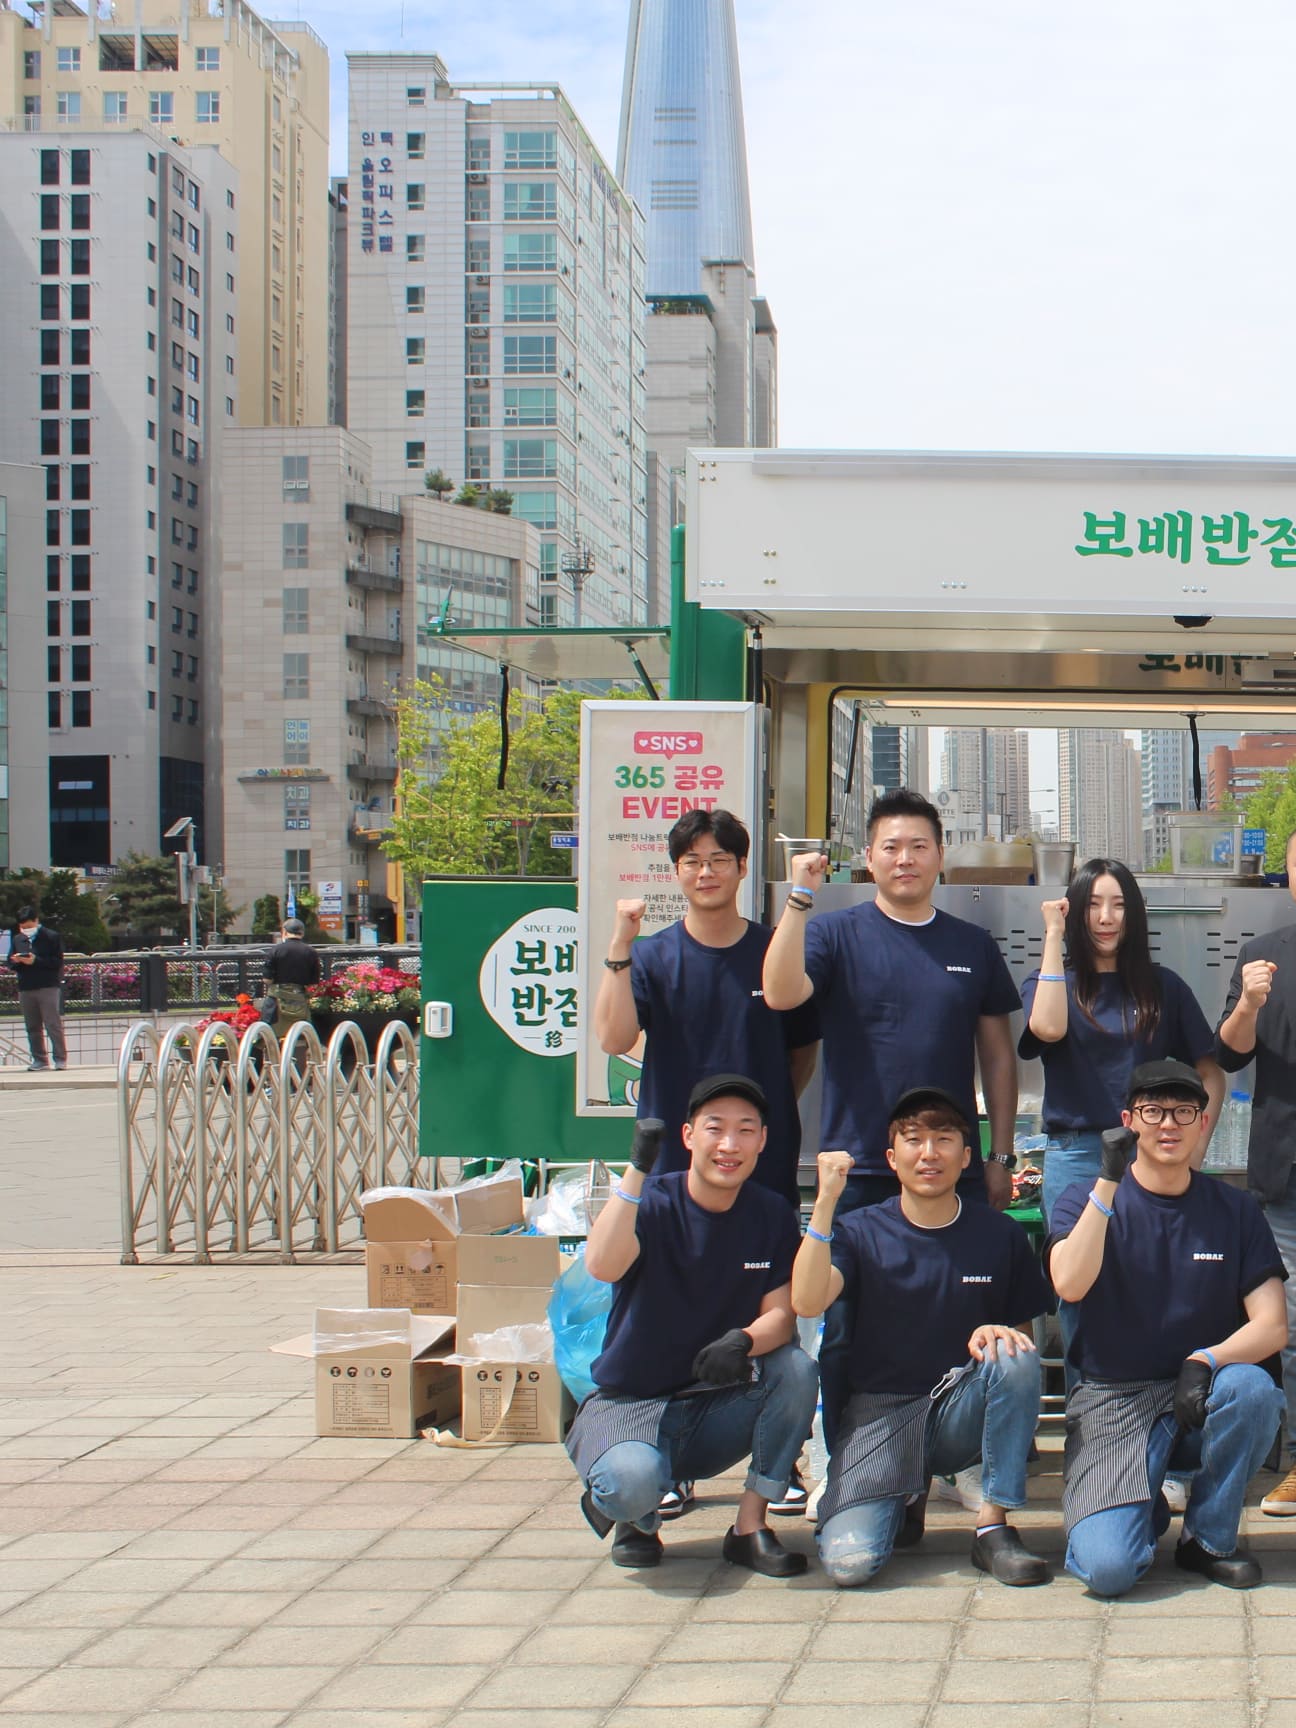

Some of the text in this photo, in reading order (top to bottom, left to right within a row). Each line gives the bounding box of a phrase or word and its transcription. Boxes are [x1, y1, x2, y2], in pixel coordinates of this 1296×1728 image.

[379, 157, 393, 252] 오피스텔
[650, 736, 687, 751] SNS
[615, 765, 725, 791] 365 공유
[623, 797, 718, 819] EVENT
[608, 833, 638, 842] 보배반점
[653, 874, 672, 882] 1만원
[644, 894, 667, 903] 자세한
[648, 904, 664, 913] 공식
[524, 924, 577, 934] SINCE 200
